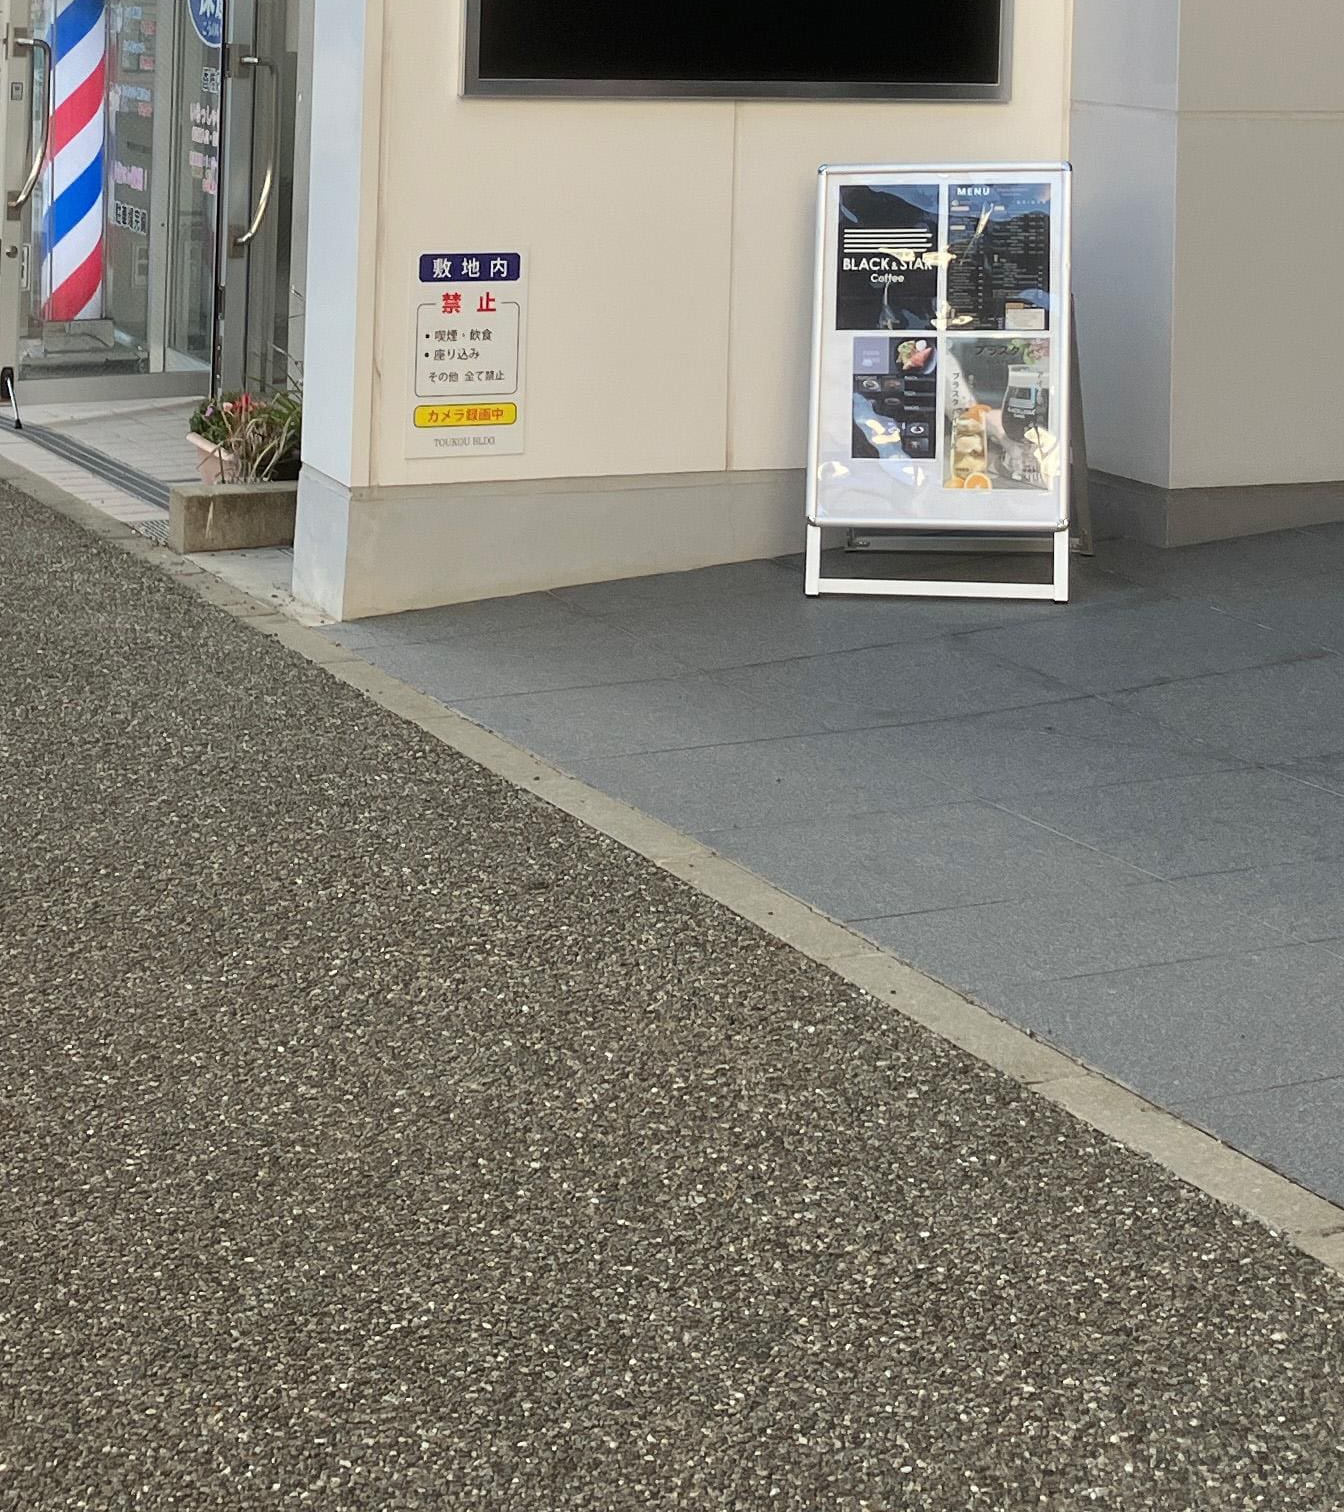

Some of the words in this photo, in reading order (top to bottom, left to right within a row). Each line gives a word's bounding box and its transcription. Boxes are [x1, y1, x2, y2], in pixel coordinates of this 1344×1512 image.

[957, 187, 990, 196] MENU
[432, 257, 508, 278] 敷地内
[842, 257, 890, 271] BLACK
[870, 273, 905, 283] Coffee
[441, 291, 497, 314] 禁止
[434, 328, 493, 342] 喫煙・飲食
[433, 348, 480, 361] 座り込み
[428, 371, 459, 383] その他
[464, 370, 505, 382] 全て禁止
[427, 407, 505, 424] カメラ録画中
[433, 437, 471, 448] TOUKOU
[472, 436, 496, 446] BLDG
